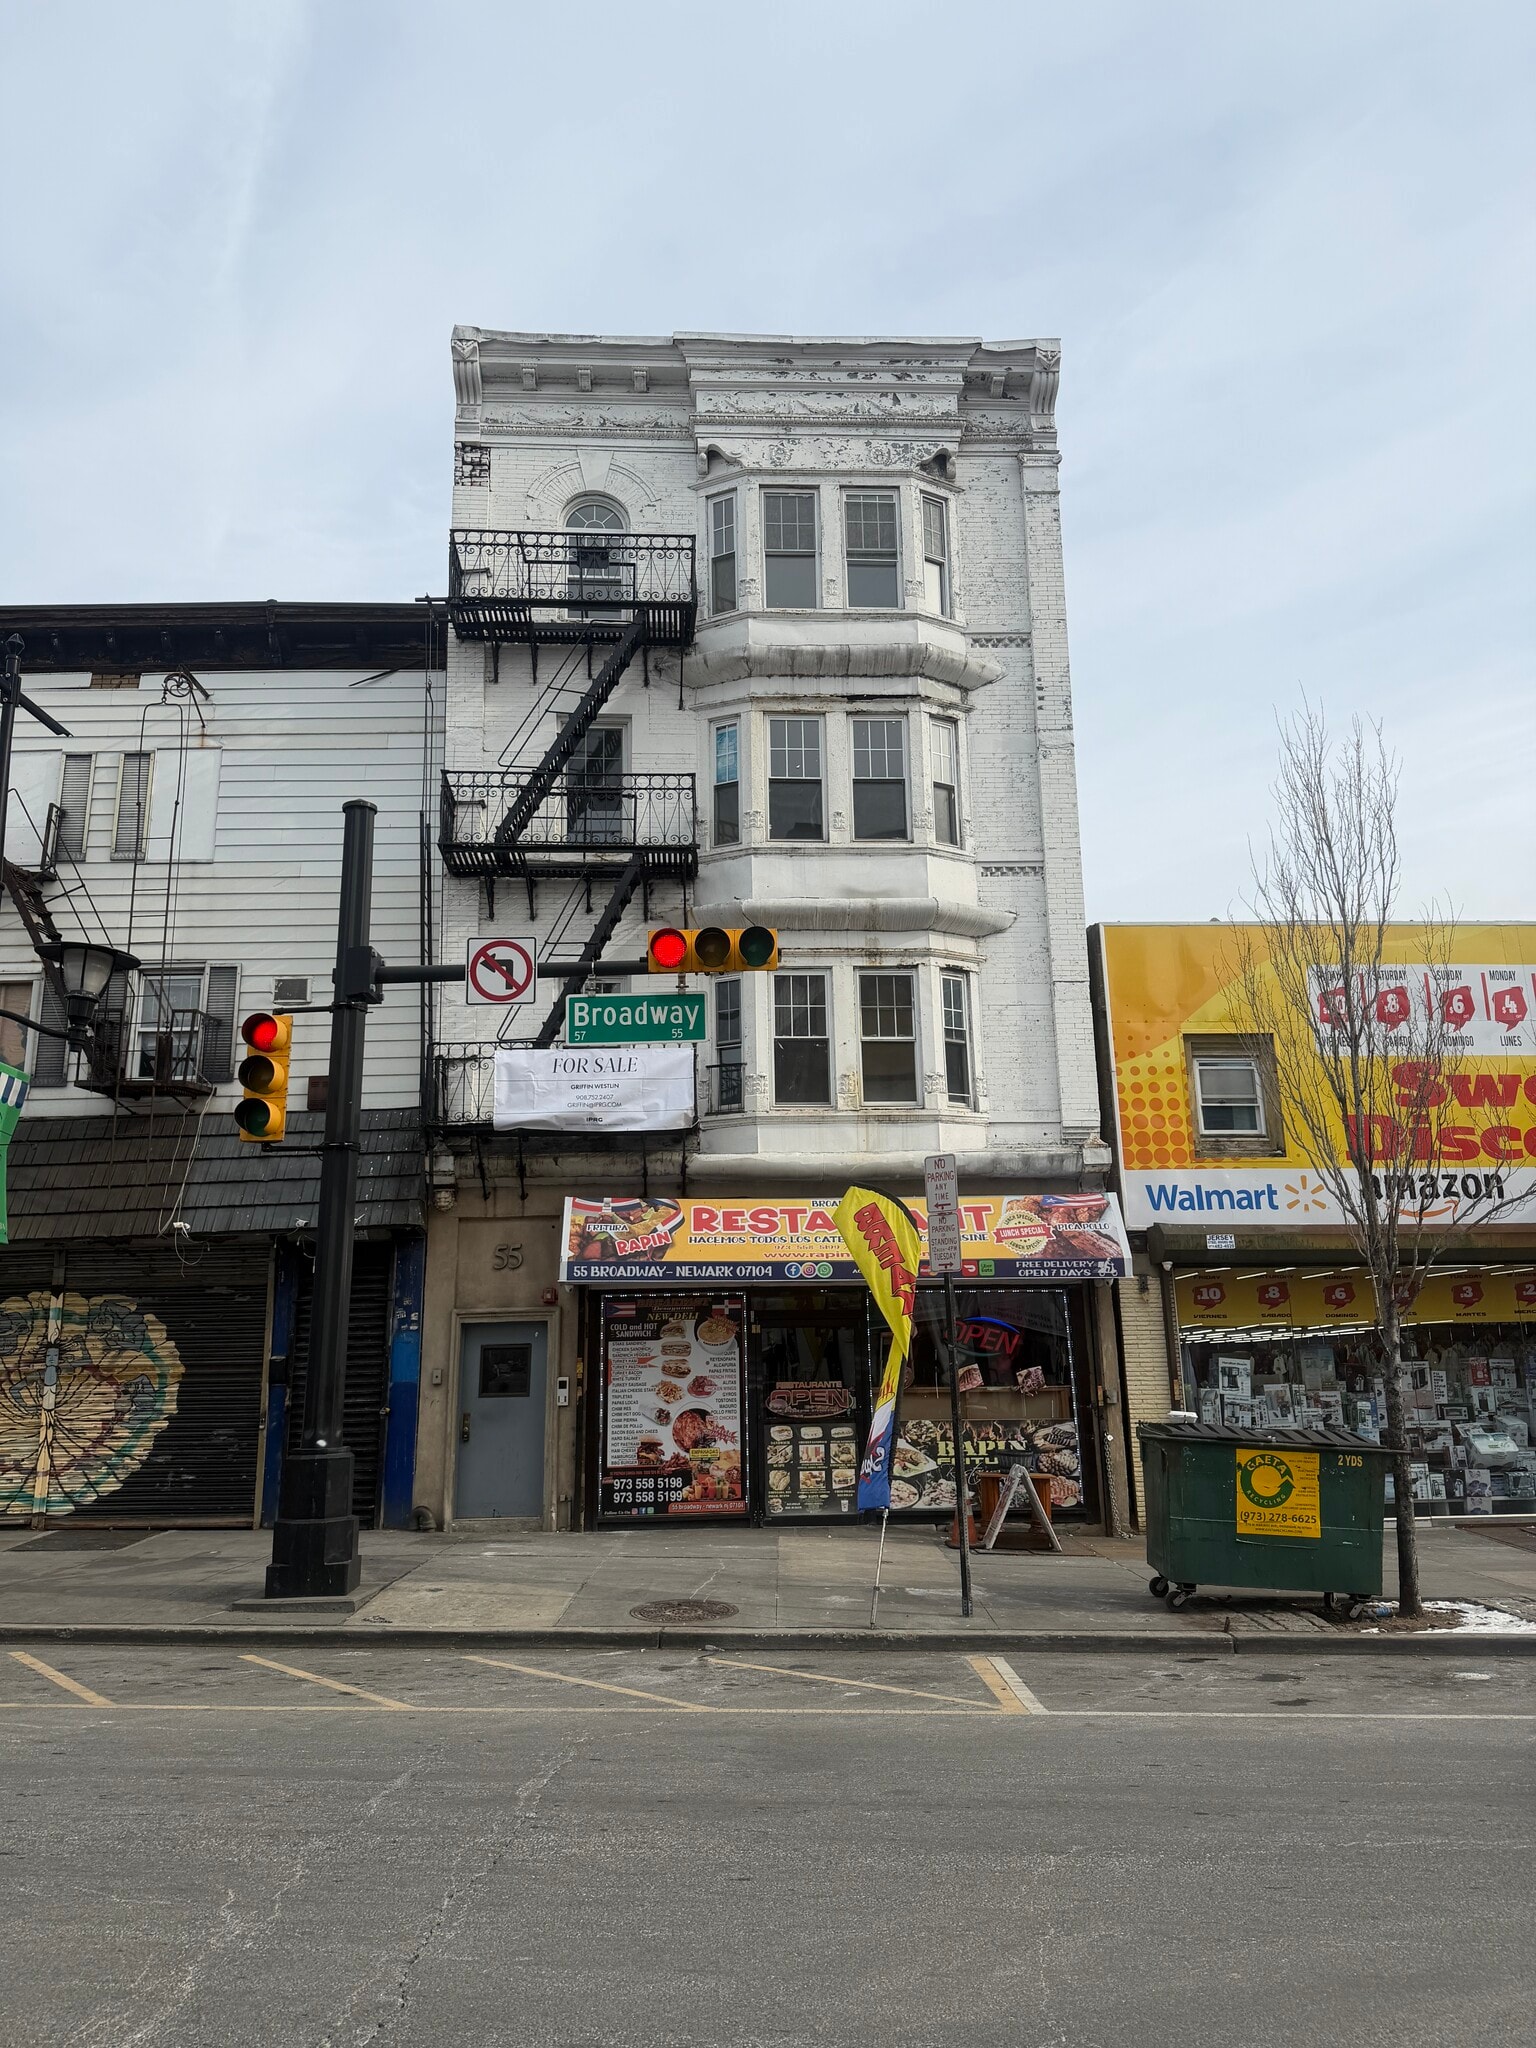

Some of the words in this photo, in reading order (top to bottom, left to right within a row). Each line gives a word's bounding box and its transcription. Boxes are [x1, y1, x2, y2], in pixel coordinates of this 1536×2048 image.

[1489, 970, 1516, 981] MONDAY
[1502, 995, 1518, 1014] $4
[574, 1001, 699, 1030] Broadway
[574, 1031, 586, 1041] 57
[671, 1028, 683, 1039] 55
[1499, 1036, 1523, 1047] LUNES
[552, 1057, 588, 1074] FOR
[593, 1057, 638, 1073] SALE
[934, 1159, 946, 1169] NO
[927, 1171, 955, 1183] PARKING
[1145, 1184, 1279, 1211] Walmart
[938, 1217, 947, 1225] NO
[1056, 1223, 1082, 1231] PICA
[1083, 1222, 1110, 1230] POLLO
[931, 1224, 956, 1234] PARKING
[1000, 1229, 1020, 1237] LUNCH
[1021, 1226, 1046, 1236] SPECIAL
[615, 1231, 671, 1255] RAPIN
[689, 1236, 746, 1244] HACEMOS
[814, 1235, 845, 1243] CATE
[931, 1237, 957, 1247] STANDING
[493, 1243, 524, 1270] 55
[934, 1252, 957, 1261] TUESDAY
[573, 1266, 588, 1277] 55
[676, 1265, 733, 1277] NEWARK
[736, 1265, 773, 1277] 07104
[610, 1323, 628, 1331] COLD
[644, 1322, 658, 1330] HOT
[616, 1330, 651, 1338] SANDWICH
[770, 1389, 849, 1409] OPEN
[1247, 1455, 1287, 1474] GAETA
[1337, 1455, 1344, 1466] 2
[1345, 1455, 1363, 1467] YDS
[613, 1478, 633, 1490] 973
[635, 1477, 655, 1489] 558
[657, 1477, 683, 1489] 5198
[613, 1491, 633, 1503] 973
[635, 1491, 655, 1503] 558
[657, 1490, 683, 1502] 5199
[1247, 1490, 1286, 1505] RECYCLING
[1240, 1511, 1266, 1522] (973)
[1269, 1512, 1317, 1524] 278-6625
